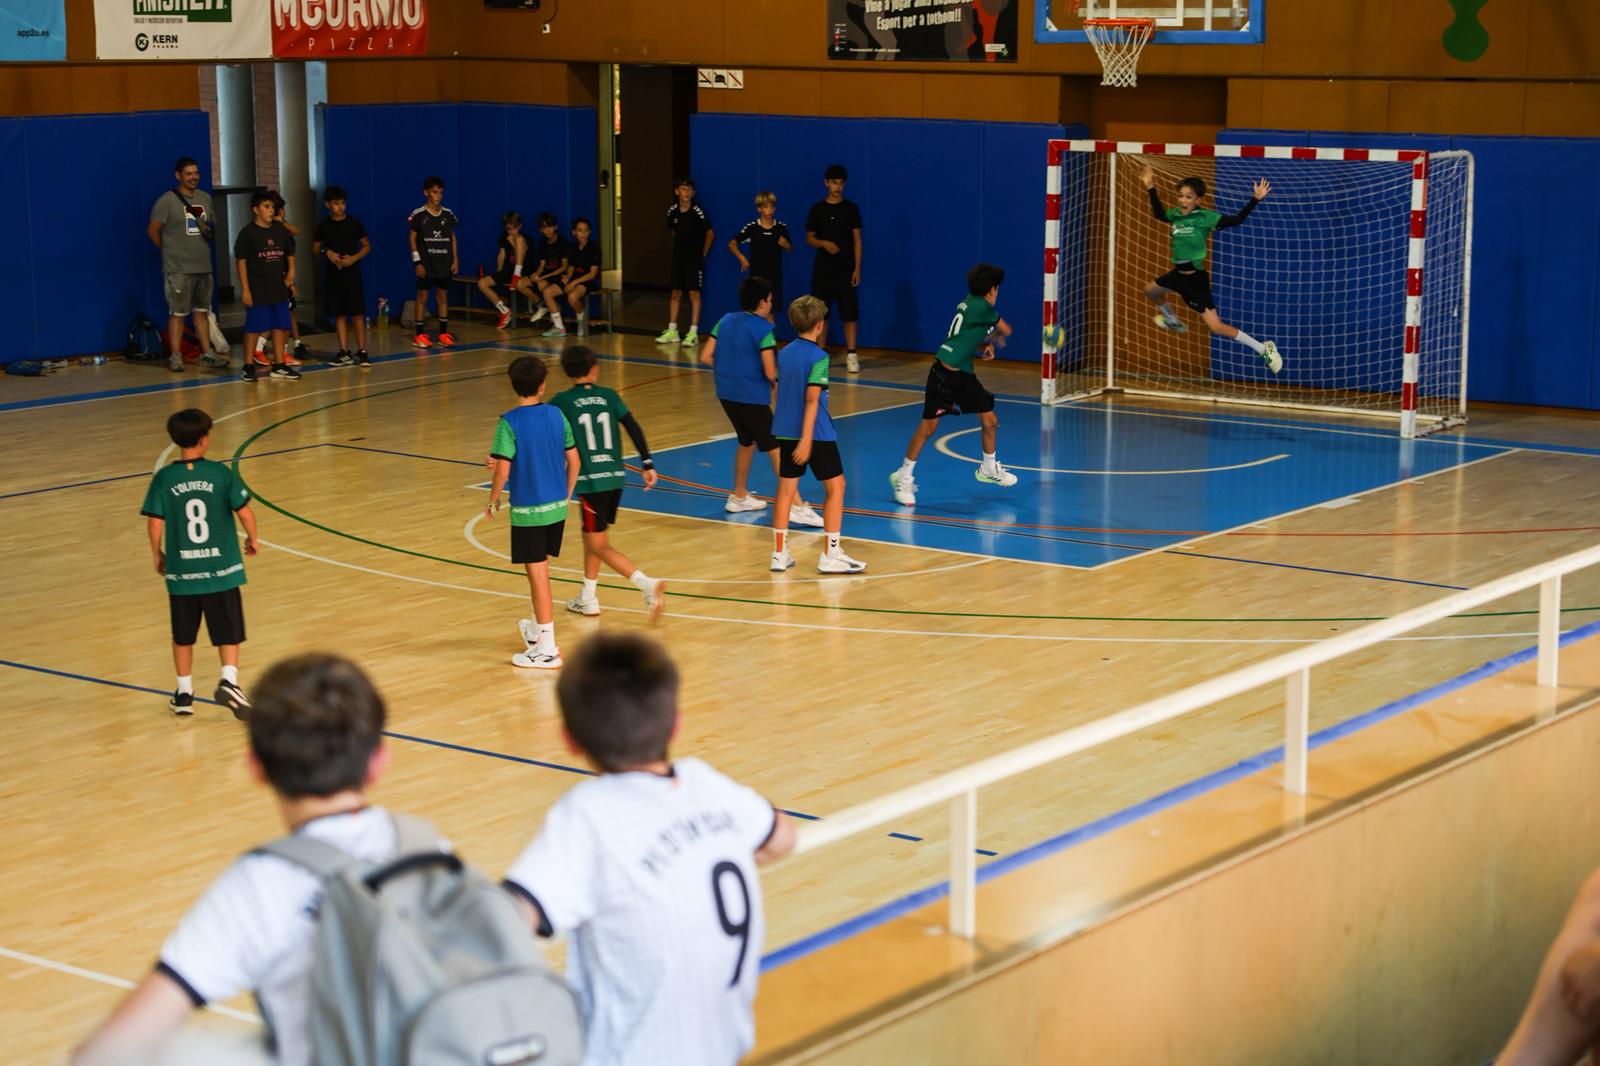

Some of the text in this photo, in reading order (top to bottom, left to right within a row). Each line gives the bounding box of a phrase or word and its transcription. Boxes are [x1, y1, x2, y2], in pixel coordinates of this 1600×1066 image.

[877, 16, 901, 31] Esport
[902, 15, 917, 29] per
[919, 14, 925, 26] a
[152, 34, 178, 44] KERN
[308, 37, 394, 51] PIZZA
[577, 411, 613, 451] 11
[170, 480, 214, 496] L'OLIVERA
[185, 498, 210, 544] 8
[711, 860, 751, 987] 9
